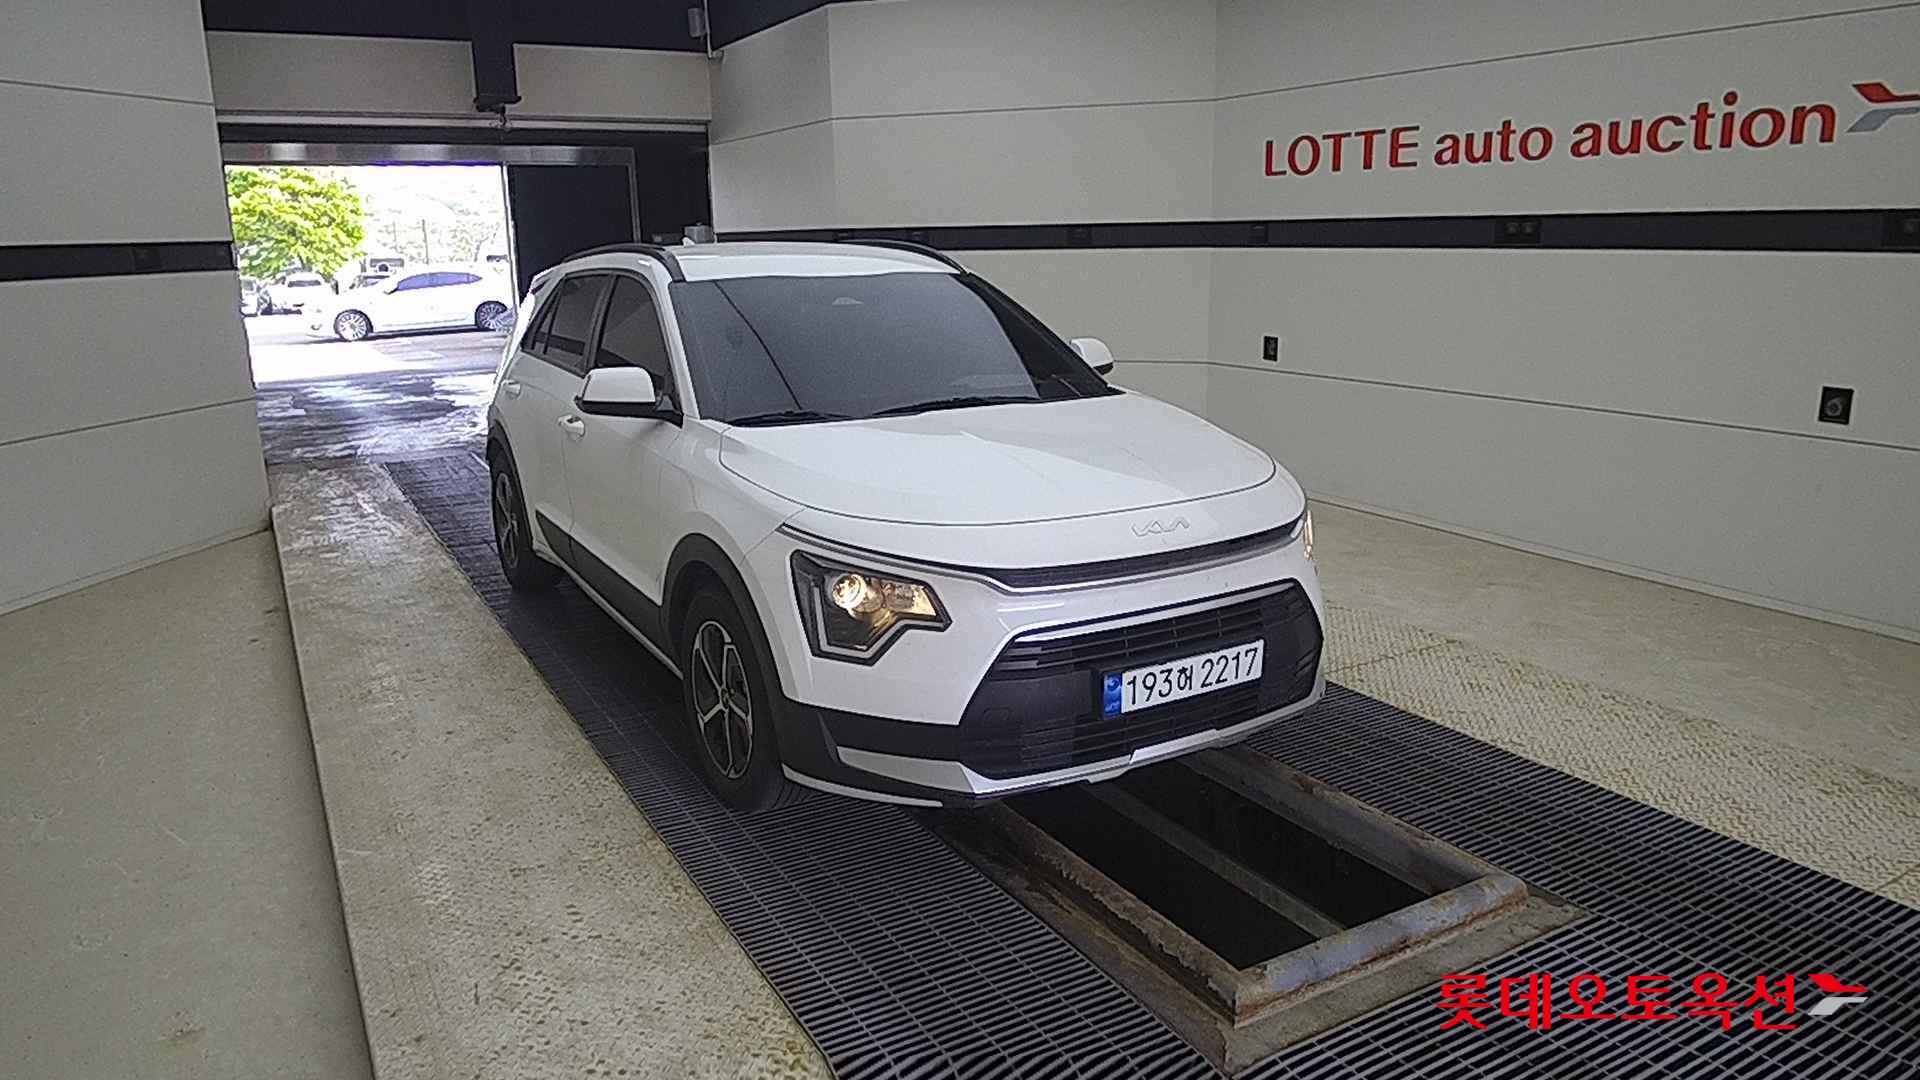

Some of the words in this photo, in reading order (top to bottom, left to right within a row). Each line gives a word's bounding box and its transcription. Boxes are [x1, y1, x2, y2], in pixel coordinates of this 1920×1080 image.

[1264, 125, 1421, 177] LOTTE
[1433, 119, 1554, 165] auto
[1570, 90, 1837, 160] auction
[1126, 663, 1195, 705] 193허
[1200, 647, 1259, 689] 2217
